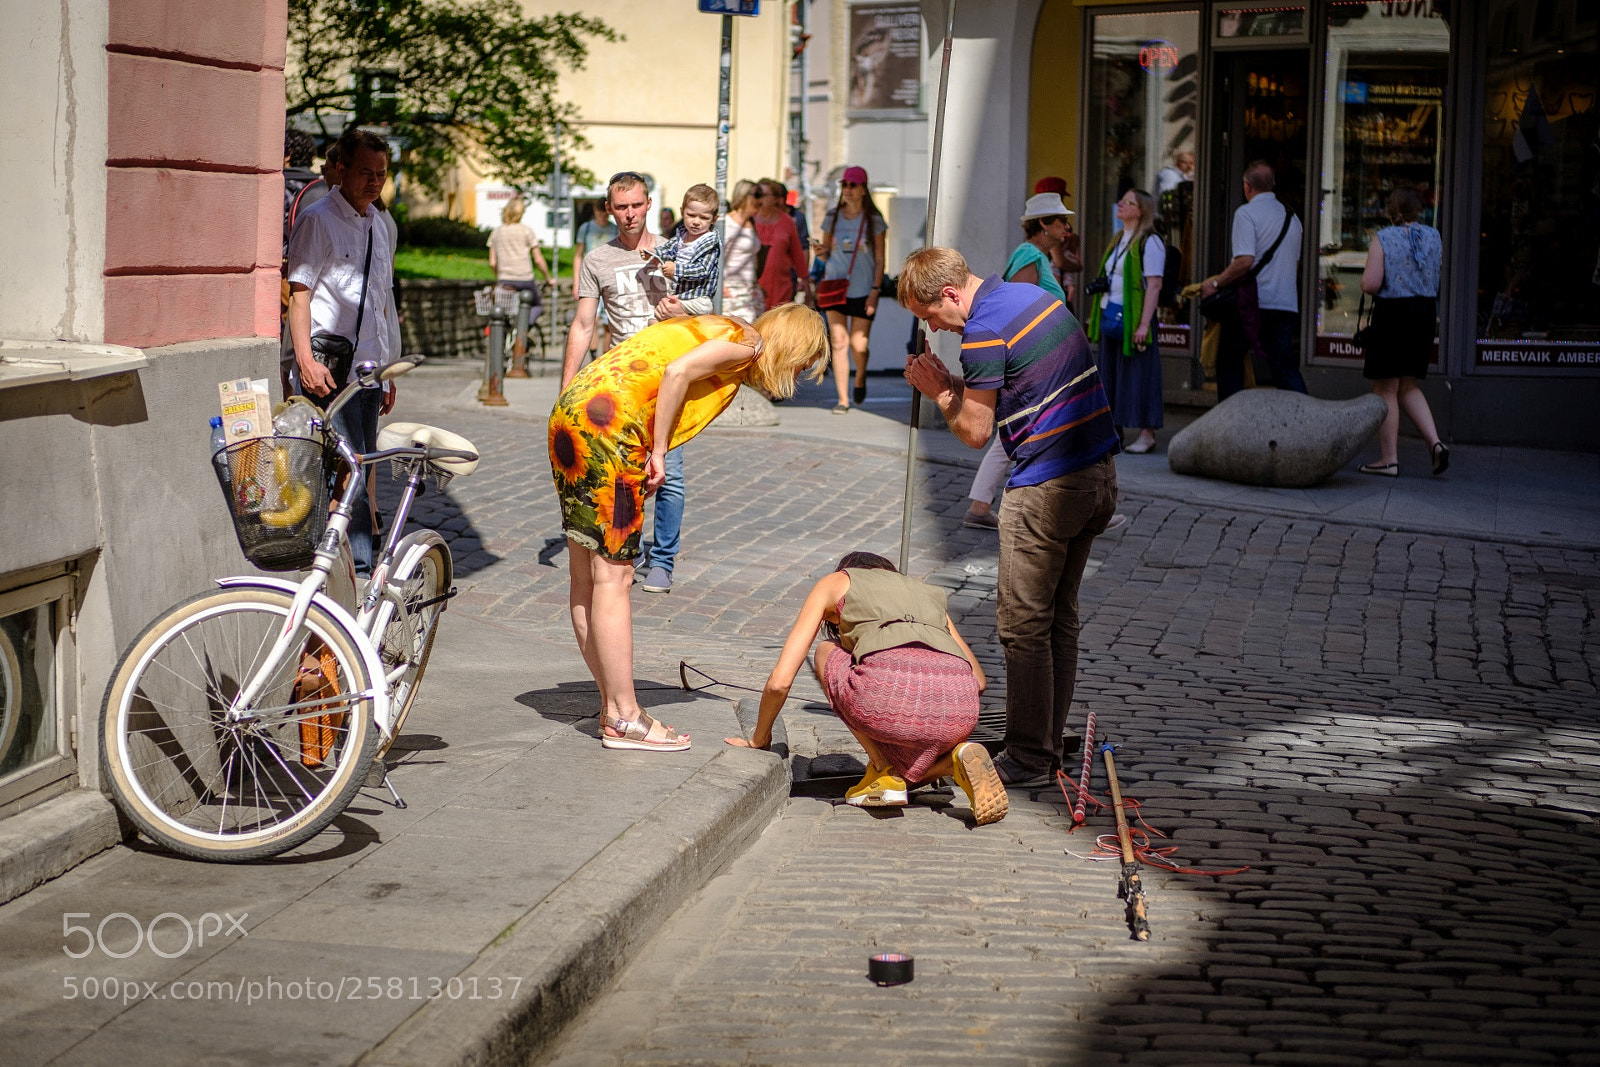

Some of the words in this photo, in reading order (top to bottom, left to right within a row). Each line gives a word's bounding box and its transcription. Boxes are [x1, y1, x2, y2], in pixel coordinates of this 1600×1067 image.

[1138, 46, 1178, 68] OPEN
[1158, 333, 1186, 345] AMICS
[1482, 350, 1551, 363] MEREVAIK
[223, 402, 255, 415] GRISSINI
